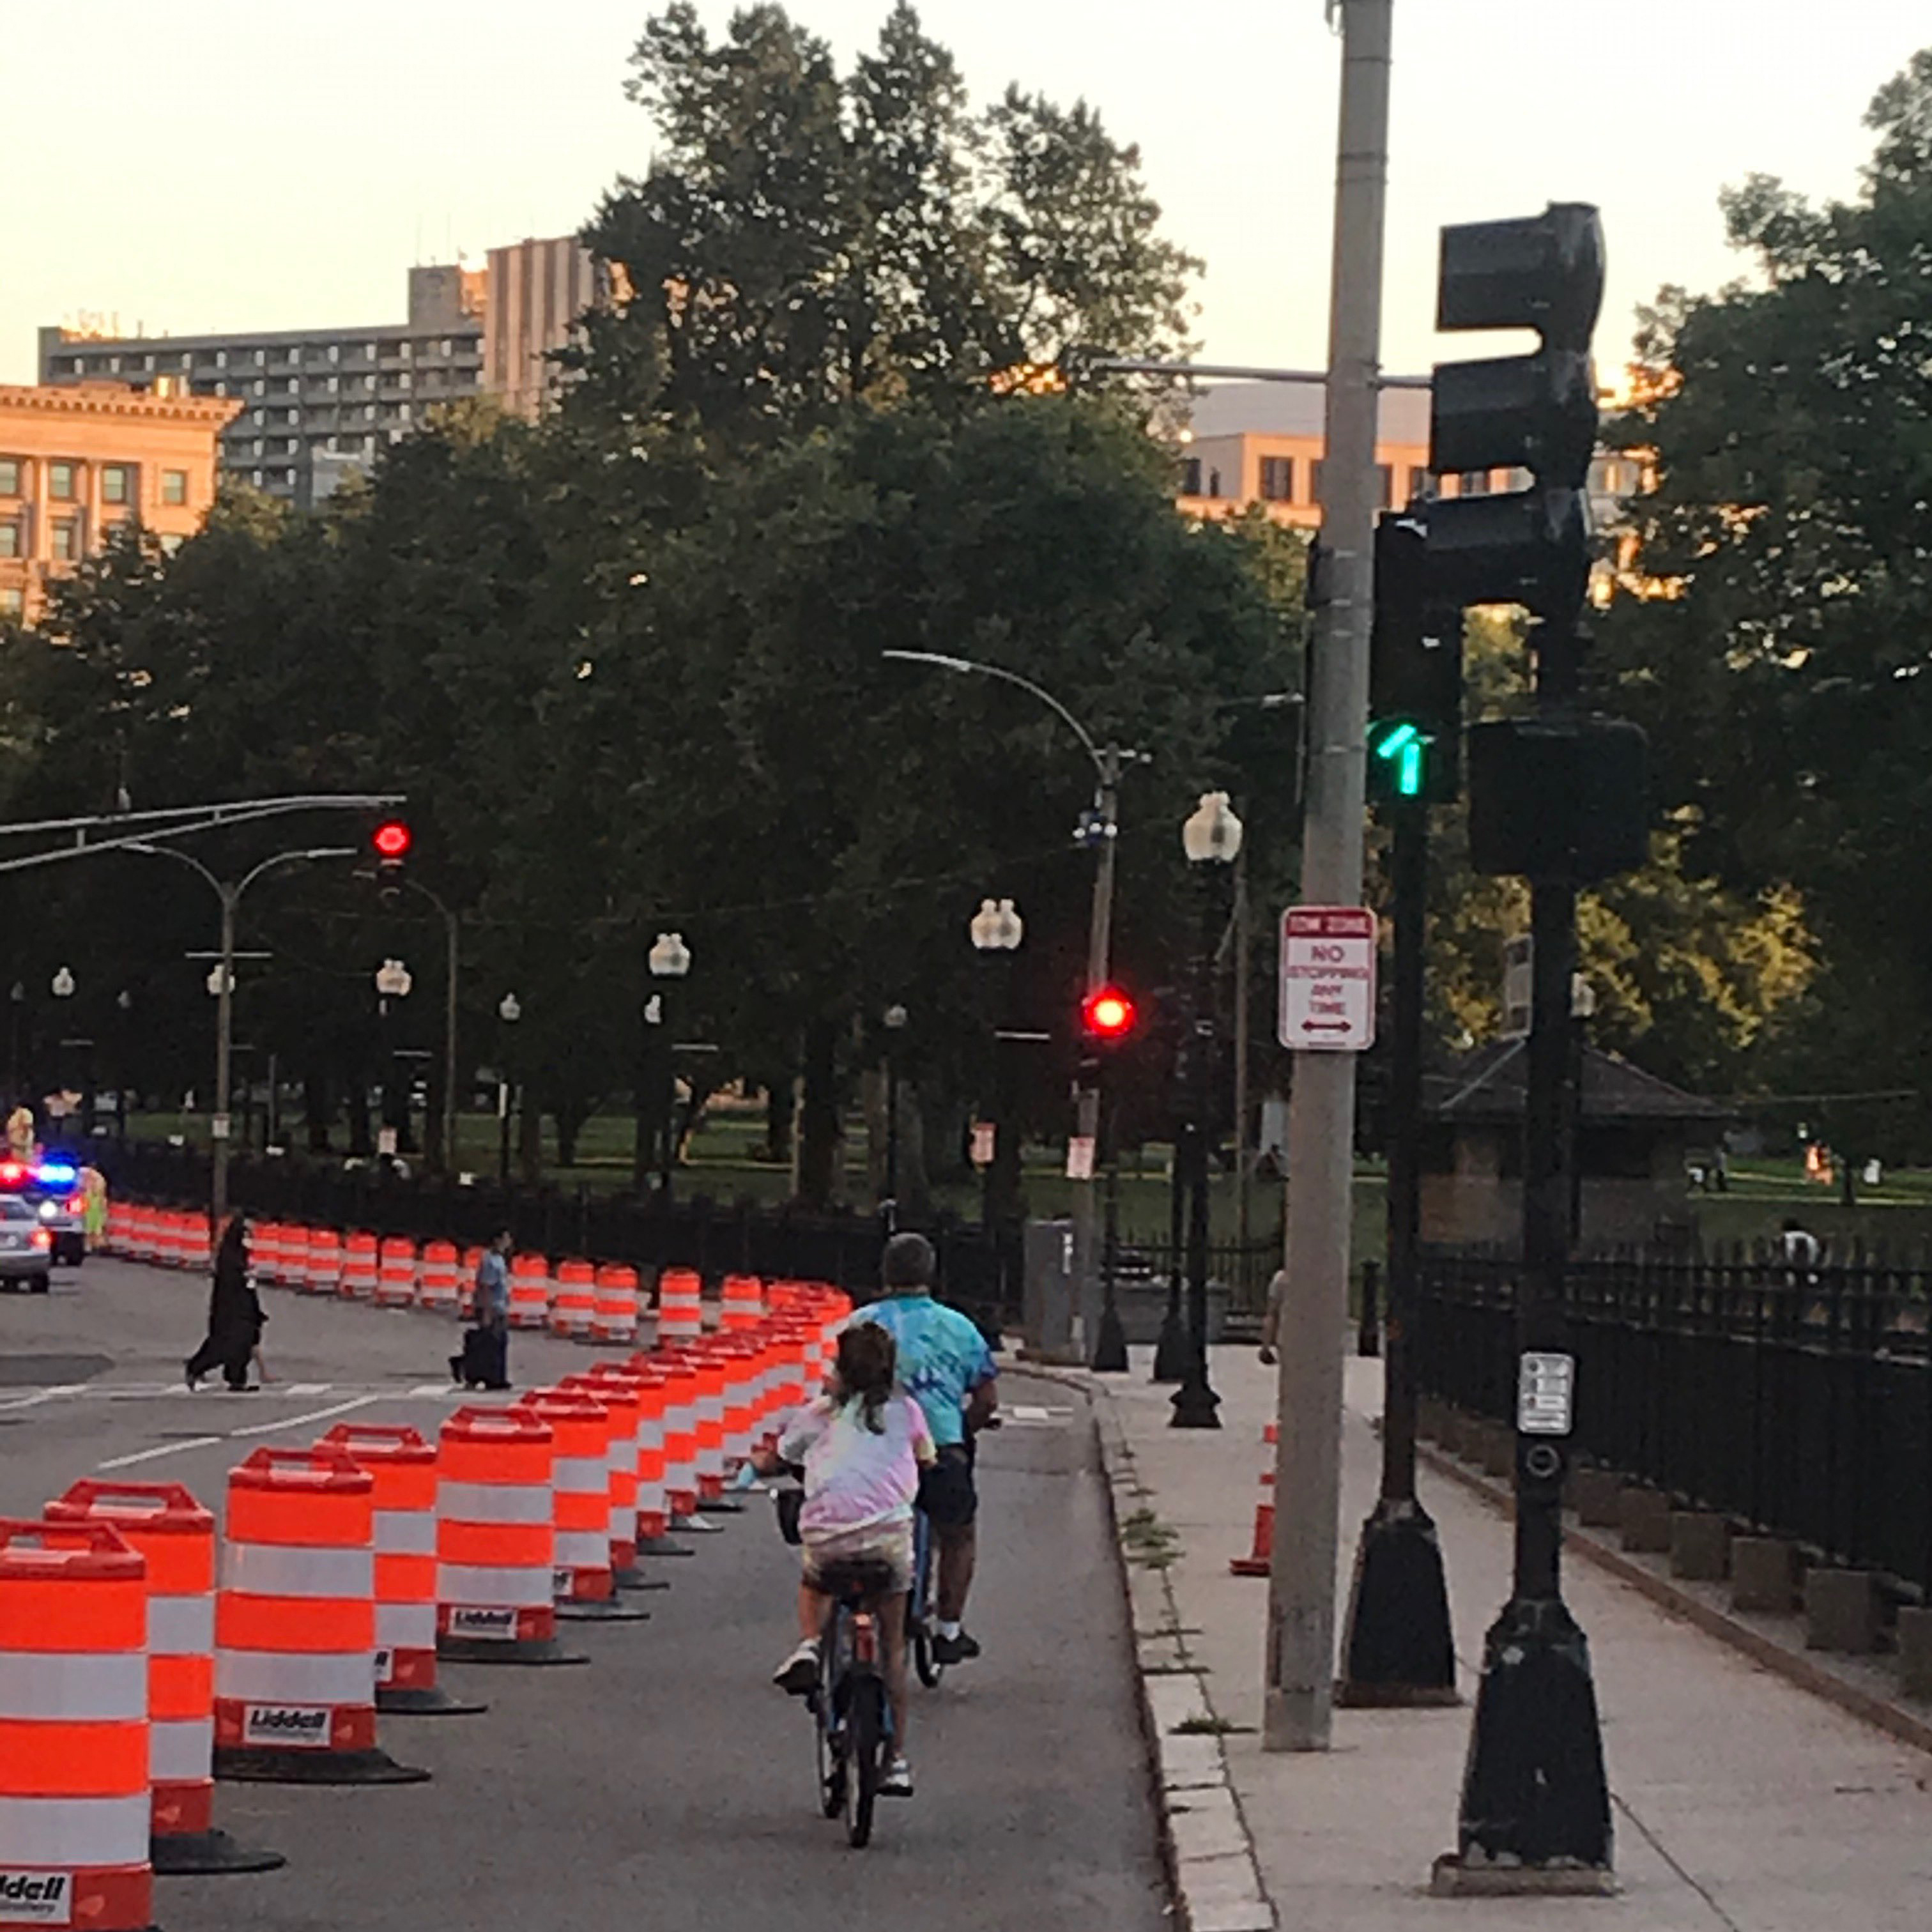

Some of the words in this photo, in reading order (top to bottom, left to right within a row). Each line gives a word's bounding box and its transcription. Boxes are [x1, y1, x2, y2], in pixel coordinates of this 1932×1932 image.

[1311, 944, 1345, 963] NO
[1311, 985, 1344, 995] ANY
[251, 1710, 326, 1728] Liddell
